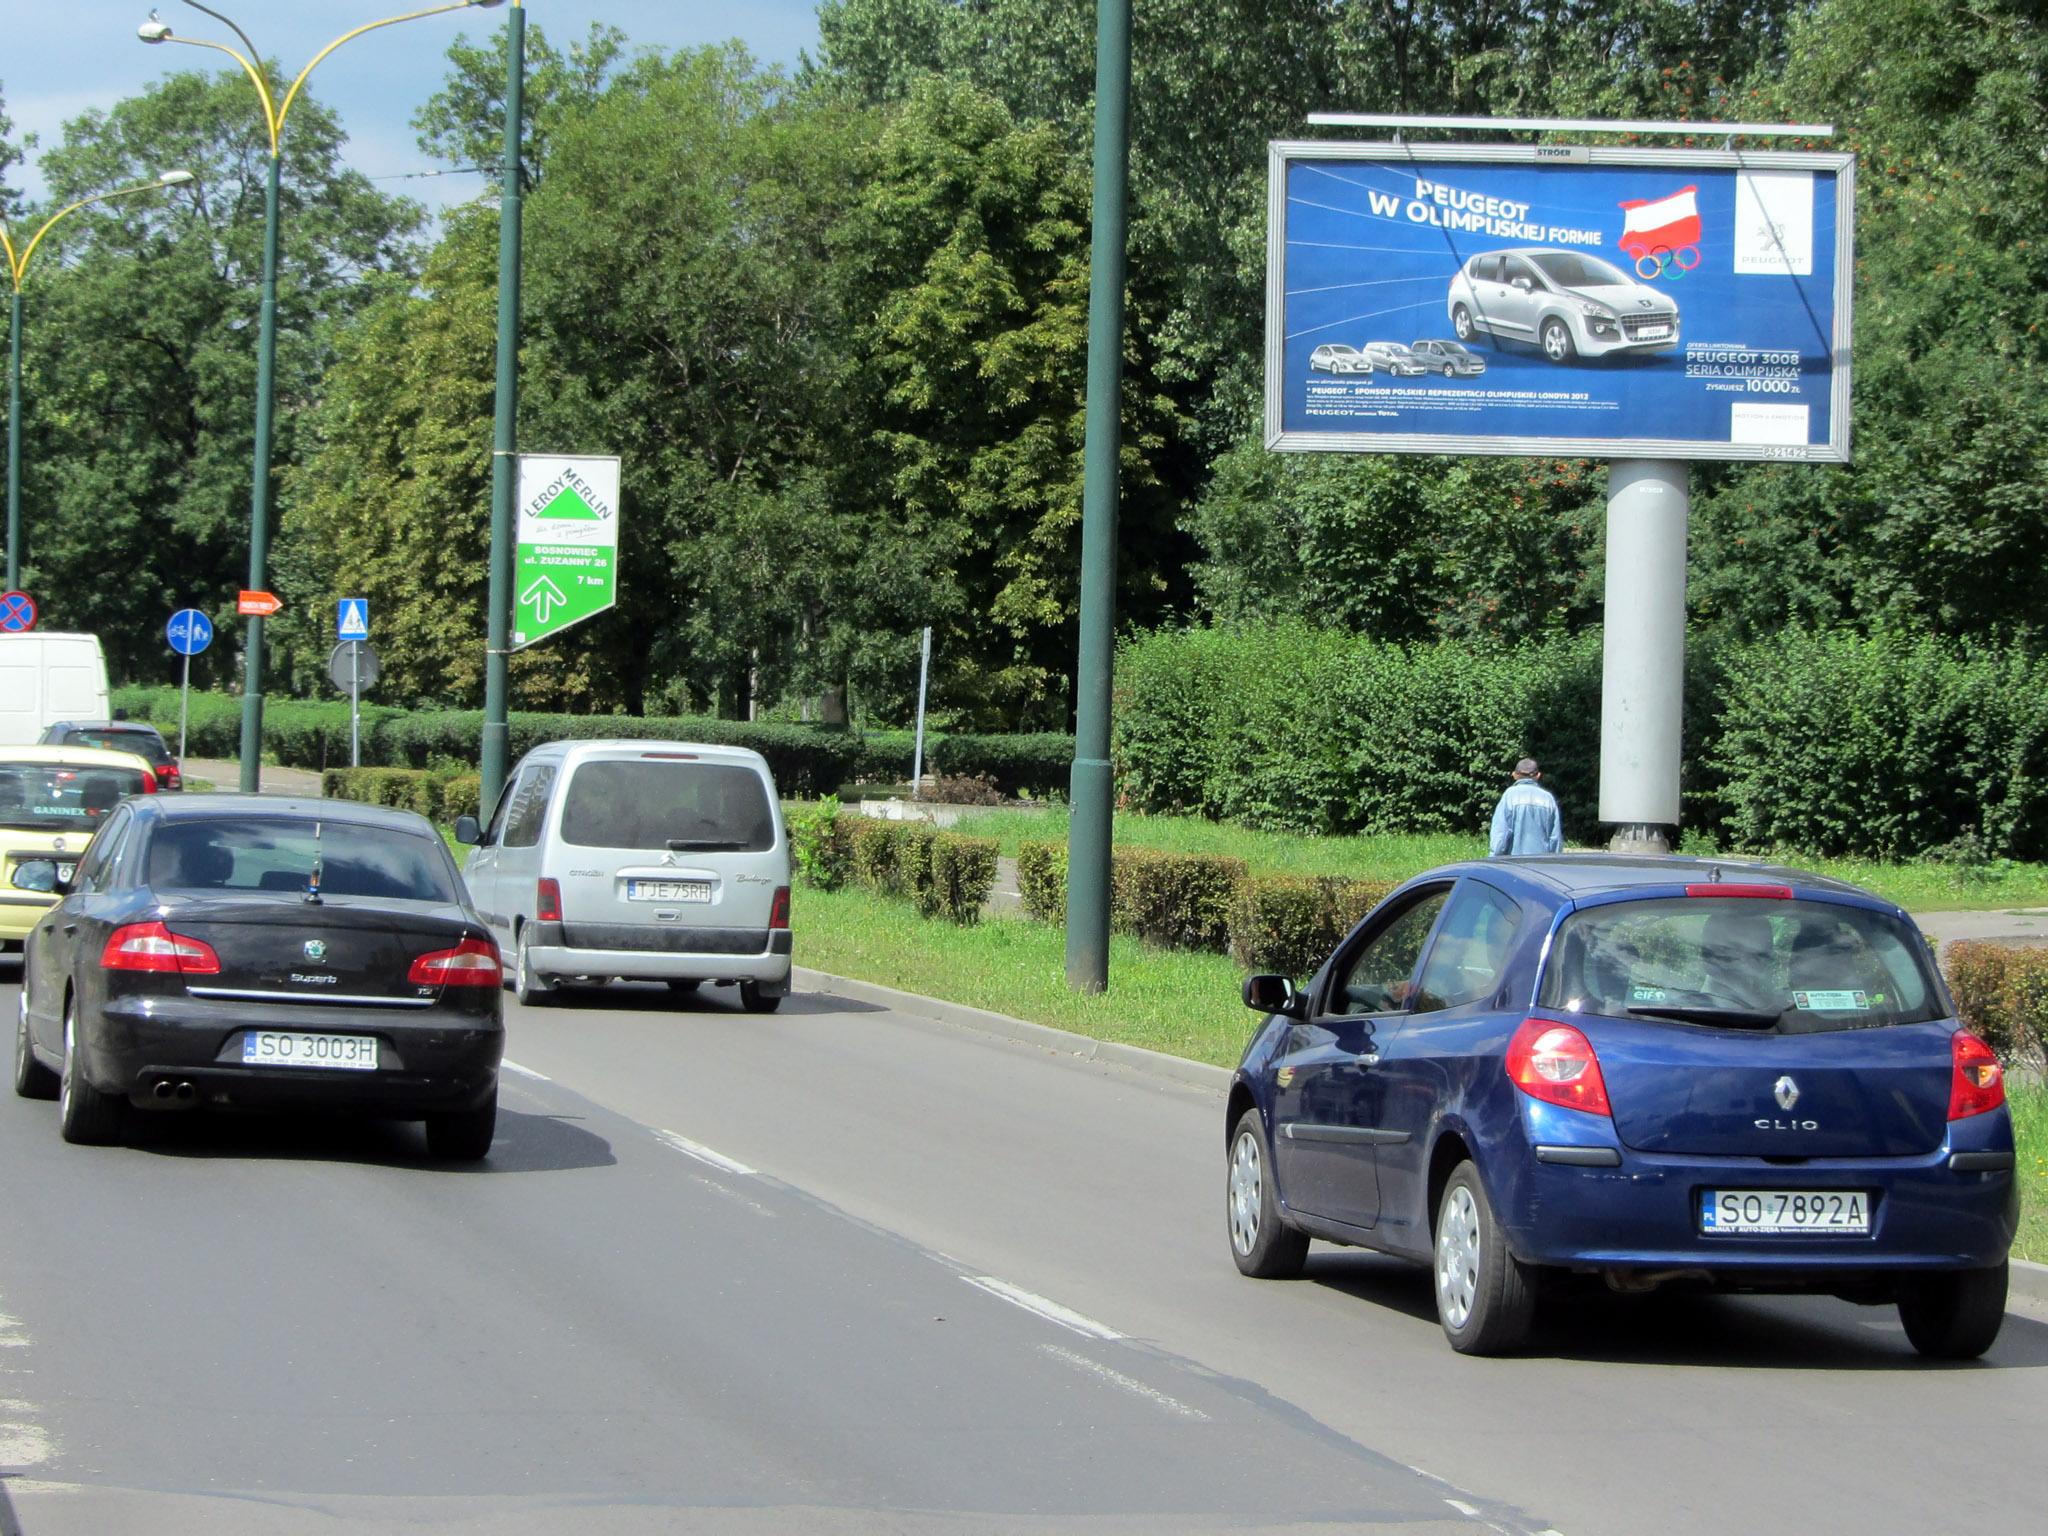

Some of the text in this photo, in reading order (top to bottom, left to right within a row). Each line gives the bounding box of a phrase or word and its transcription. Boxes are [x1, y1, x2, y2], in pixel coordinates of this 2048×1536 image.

[1415, 178, 1530, 222] PEUGEOT
[1367, 190, 1602, 246] W OLIMPIJSKIEJ FORMIE
[1742, 255, 1805, 265] PEUGEOT
[1686, 351, 1800, 366] PEUGEOT 3008
[1686, 364, 1721, 376] SERIA
[1311, 387, 1348, 395] PEUGEOT
[1354, 387, 1391, 396] SPONSOR
[1392, 388, 1426, 397] POLSKIEJ
[1427, 389, 1486, 399] REPREZENTACJI
[1486, 391, 1537, 400] OLIMPIJSKIEJ
[1570, 393, 1589, 401] 2012
[1705, 383, 1745, 393] ZYSKUJESZ
[524, 467, 613, 521] LEROY MERLIN
[534, 546, 598, 556] SOSNOWIEC
[524, 557, 608, 568] ul. ZUZANNY 26
[577, 575, 604, 586] 7 km
[33, 806, 87, 816] GANINEX
[637, 882, 709, 899] TJE 75RH
[290, 972, 338, 985] Superb
[260, 1033, 374, 1062] SO 3003H
[1753, 1118, 1819, 1131] CLIO
[1720, 1193, 1863, 1225] SO 7892A
[1703, 1212, 1716, 1222] PL
